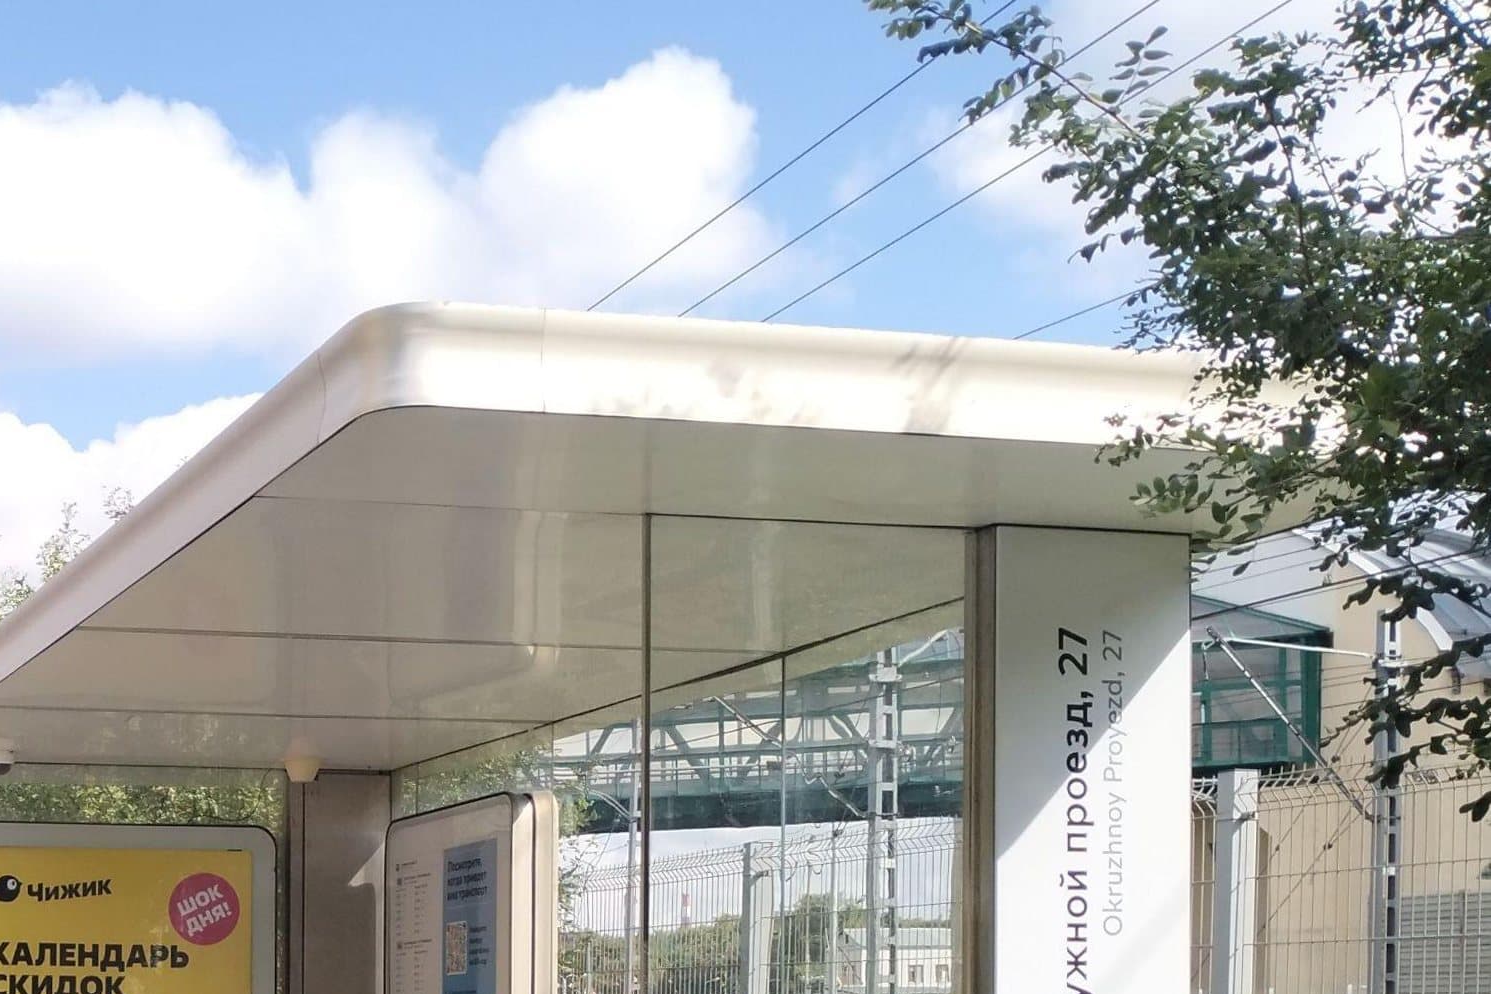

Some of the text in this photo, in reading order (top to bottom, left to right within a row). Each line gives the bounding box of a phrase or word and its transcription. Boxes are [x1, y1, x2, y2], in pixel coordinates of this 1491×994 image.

[1058, 627, 1089, 676] 27
[1065, 691, 1094, 853] проезд,
[1103, 630, 1128, 936] Okruzhnoy Proyezd, 27
[27, 879, 112, 902] Чижик
[177, 884, 224, 917] ШОК
[185, 901, 232, 937] ДНЯ!
